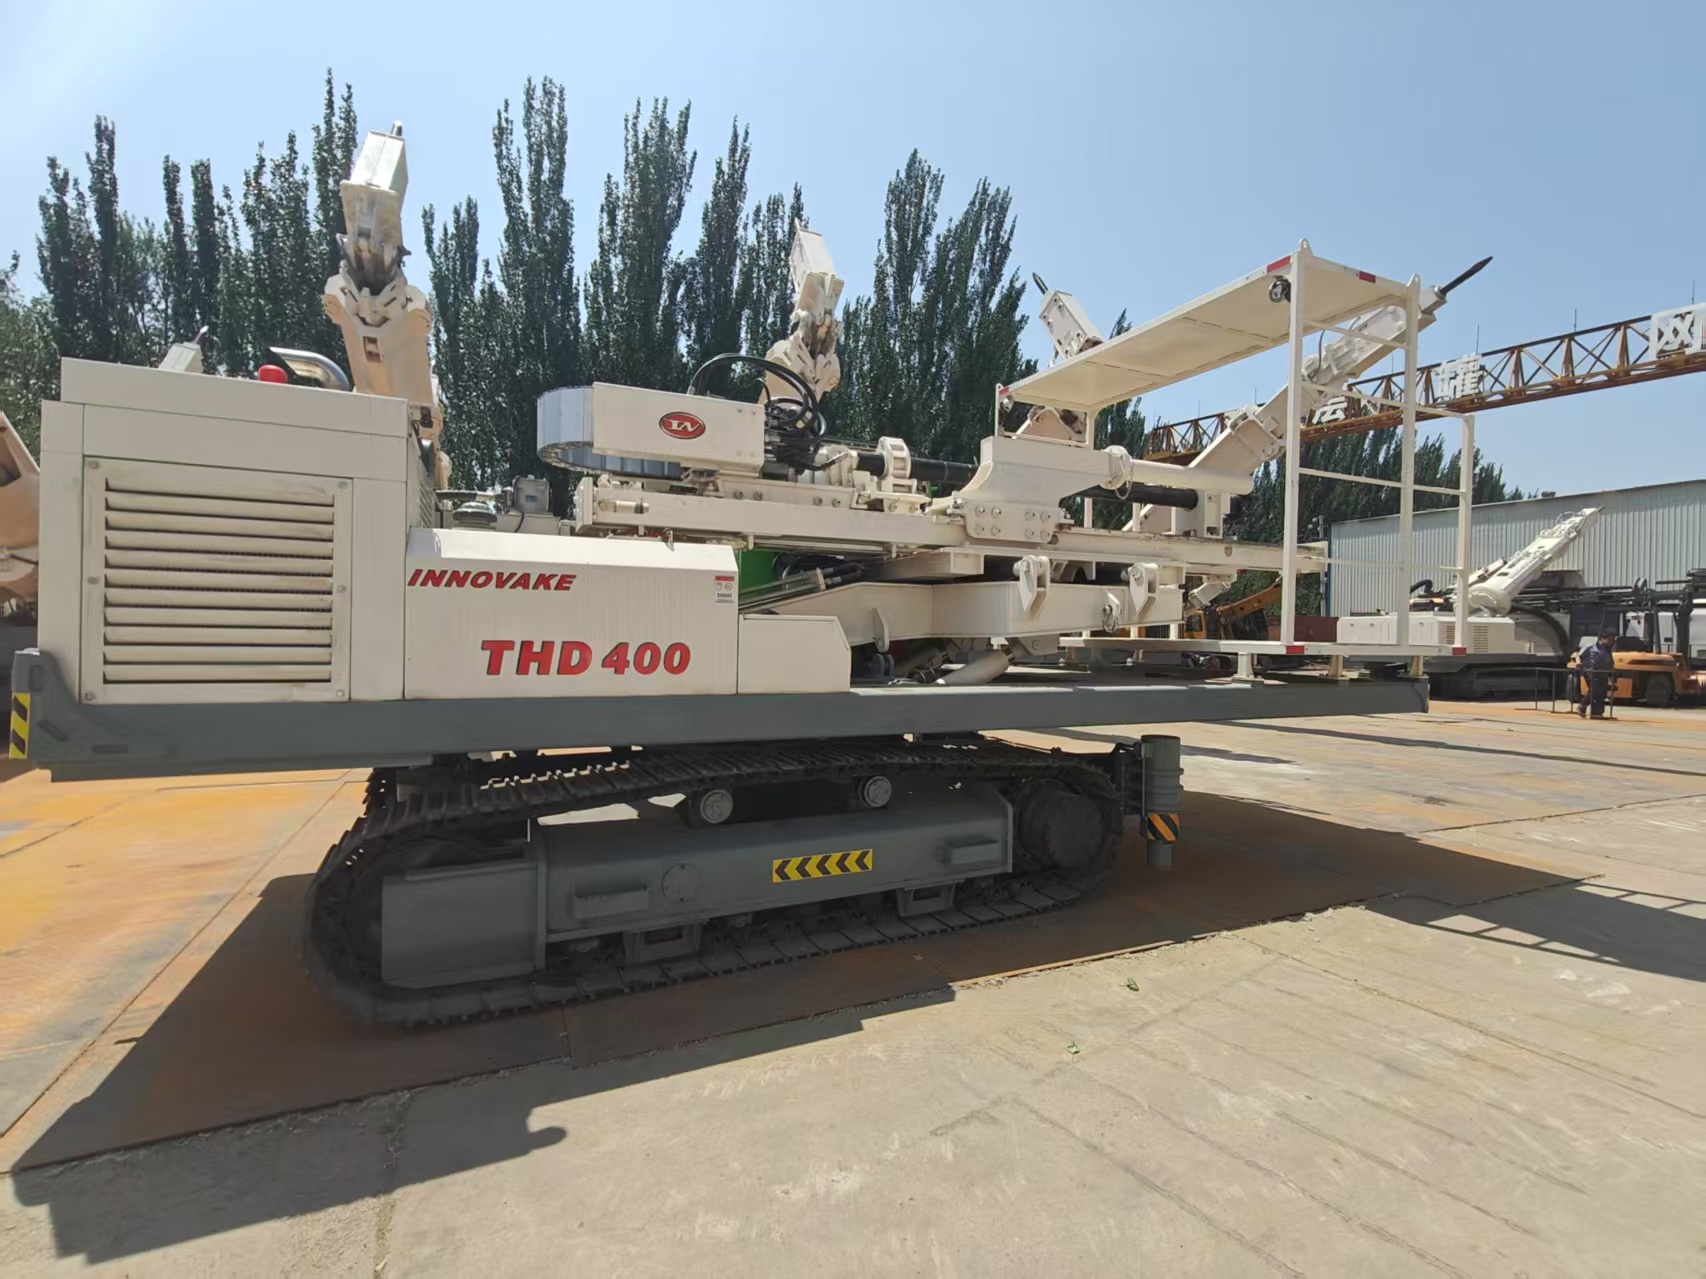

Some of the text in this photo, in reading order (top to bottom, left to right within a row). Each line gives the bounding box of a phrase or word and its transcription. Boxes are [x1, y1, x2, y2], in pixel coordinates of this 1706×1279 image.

[407, 568, 577, 591] INNOVAKE
[481, 640, 691, 676] THD 400
